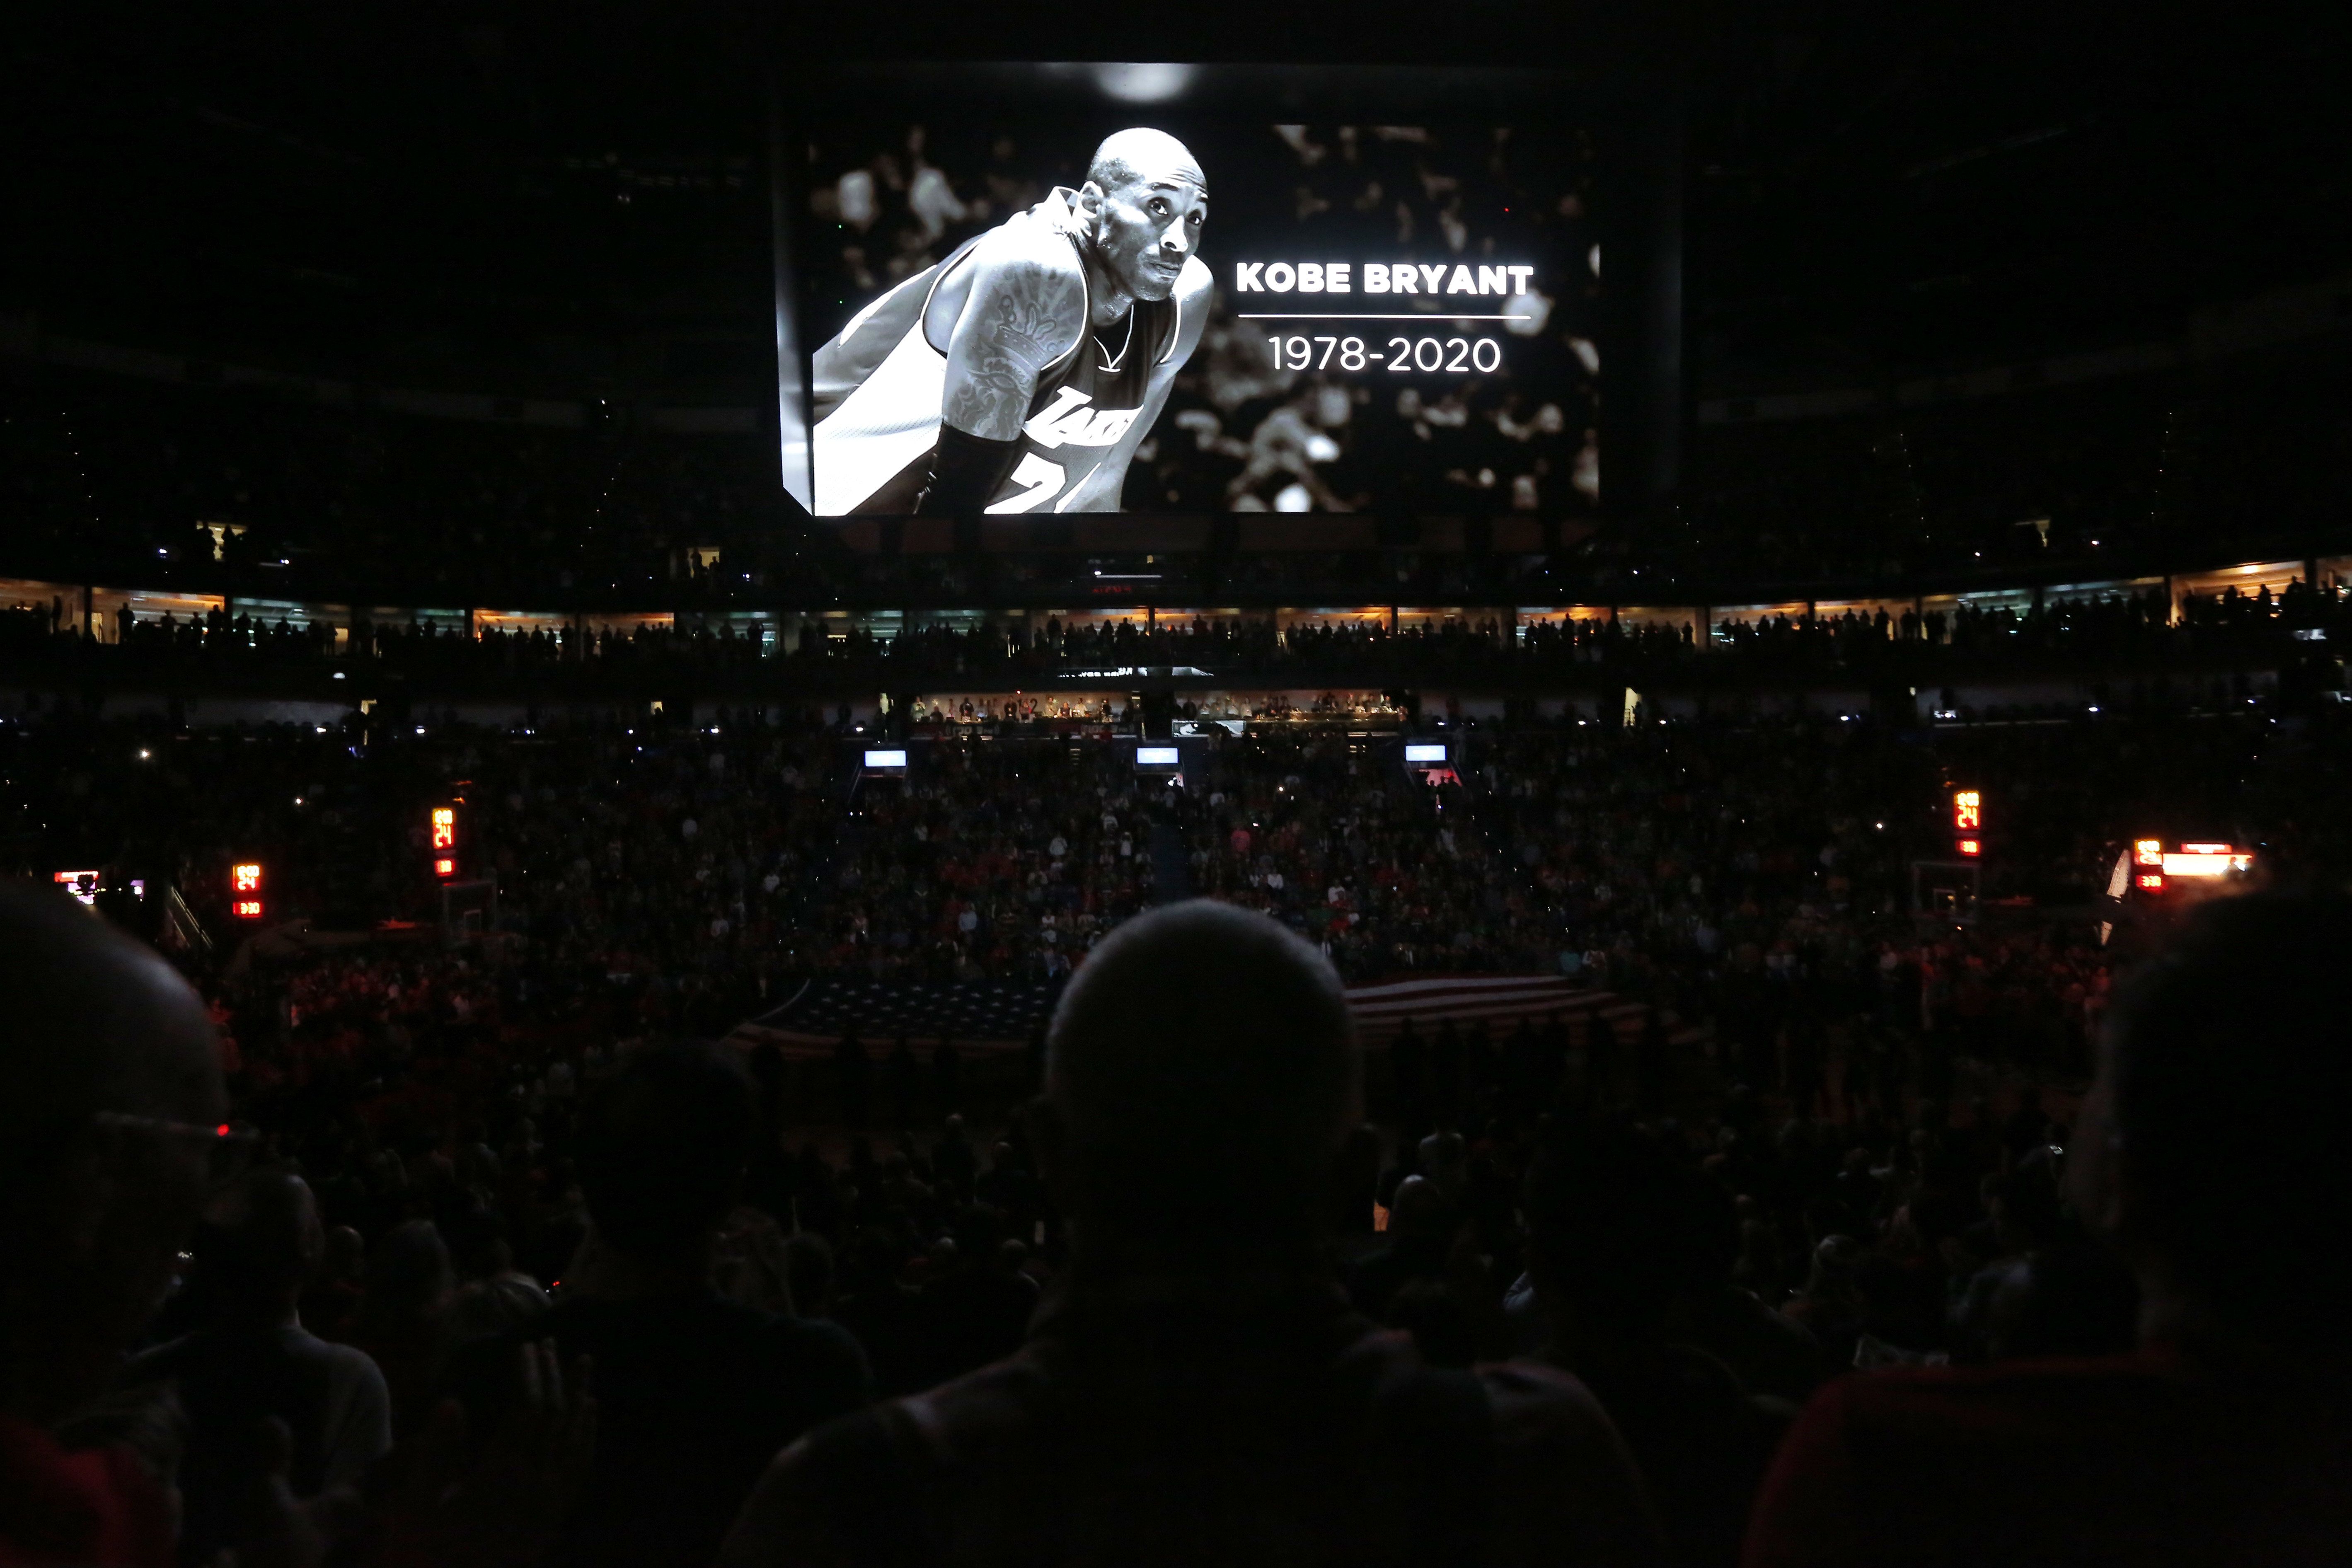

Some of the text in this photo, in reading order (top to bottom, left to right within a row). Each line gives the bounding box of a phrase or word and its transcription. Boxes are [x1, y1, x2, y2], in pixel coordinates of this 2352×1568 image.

[1237, 263, 1533, 295] KOBE BRYANT
[1269, 336, 1500, 372] 1978-2020
[1017, 698, 1038, 714] 12
[1958, 806, 1977, 828] 24
[435, 824, 452, 847] 24
[238, 876, 255, 890] 24
